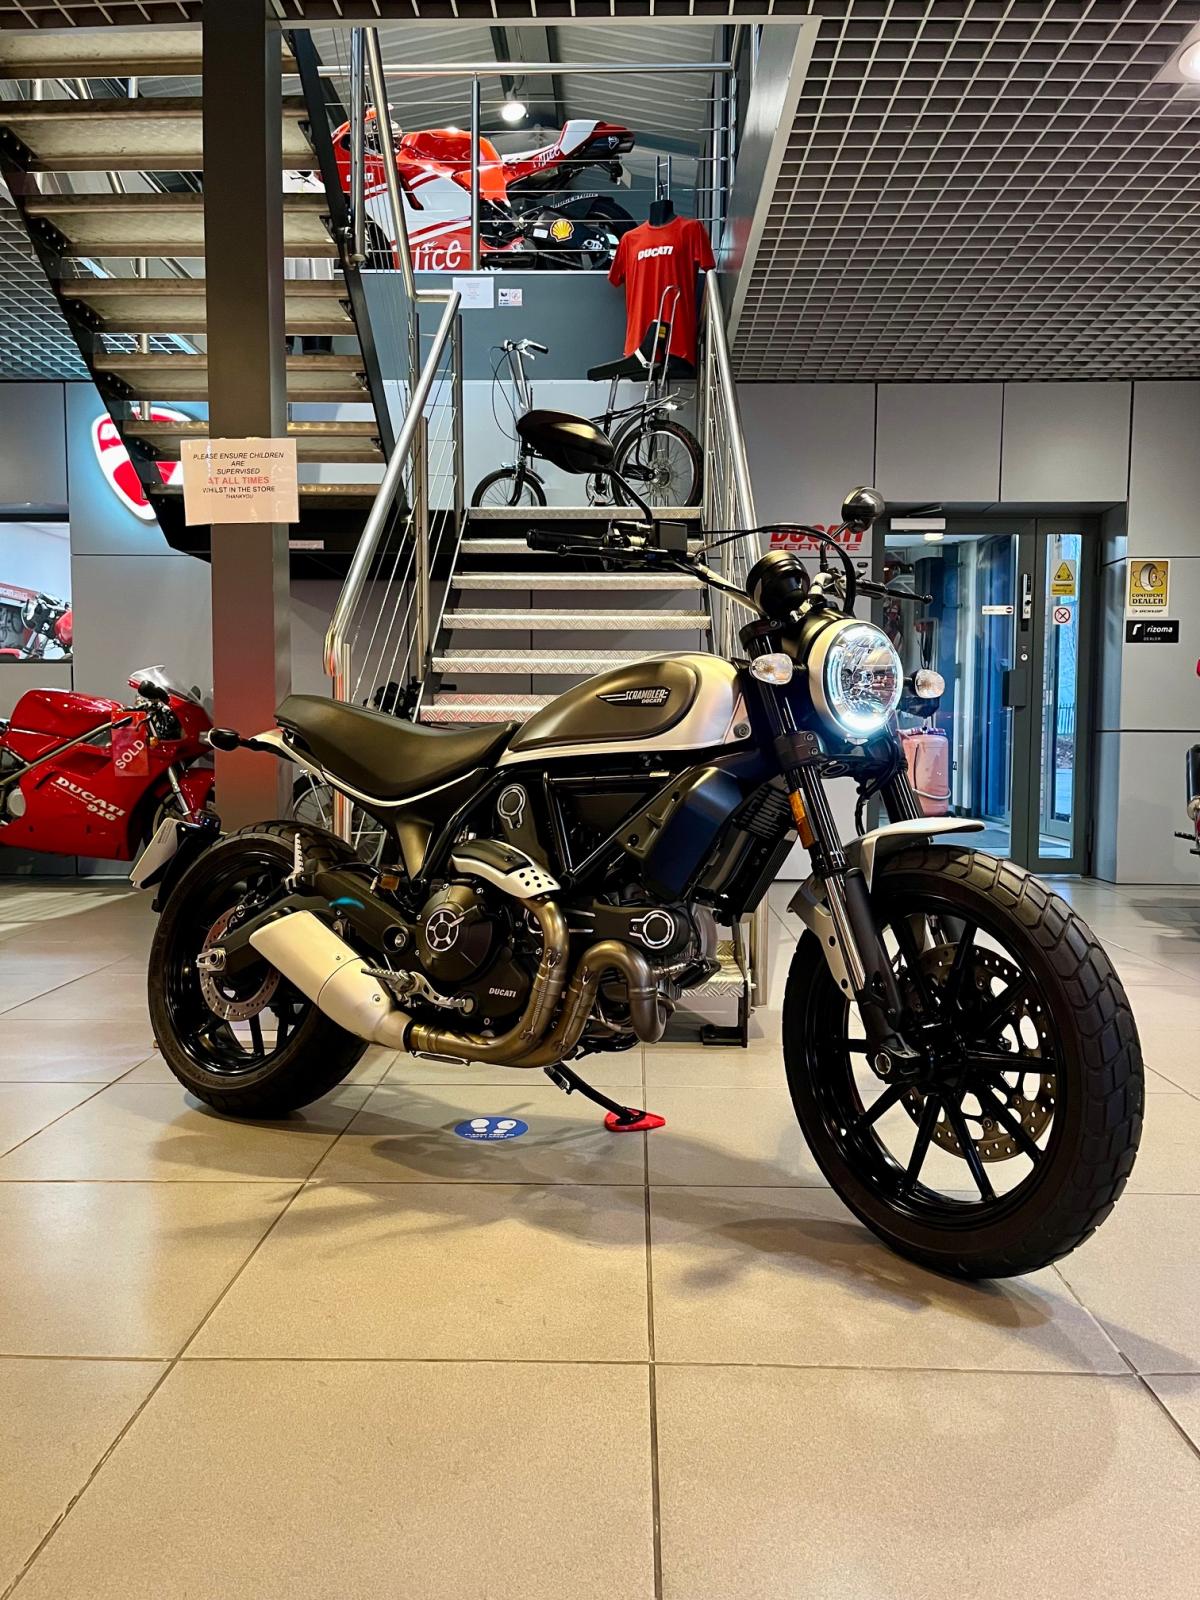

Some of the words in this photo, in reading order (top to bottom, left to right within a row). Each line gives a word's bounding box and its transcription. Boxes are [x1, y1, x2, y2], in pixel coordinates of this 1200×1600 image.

[413, 239, 462, 271] lice
[637, 245, 674, 261] DUCATI
[249, 451, 284, 459] CHILDREN
[216, 467, 261, 475] SUPERVISED
[208, 477, 219, 485] AT
[222, 476, 239, 485] ALL
[242, 476, 270, 484] TIMES
[1146, 625, 1173, 633] rizoma
[625, 689, 667, 700] SCRAMBLER
[115, 740, 145, 769] SOLD
[55, 776, 126, 816] DUCATI
[86, 804, 117, 821] 916
[488, 987, 517, 998] DUCATI
